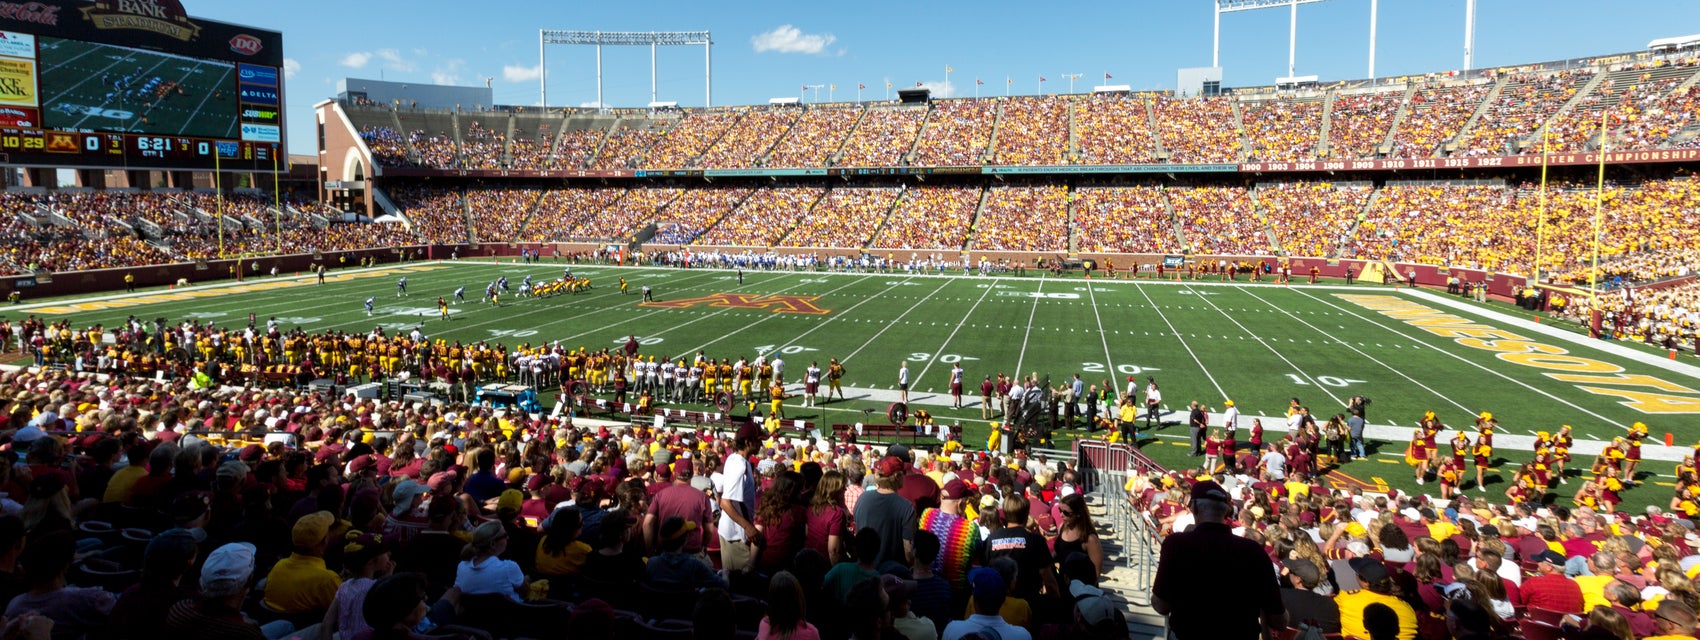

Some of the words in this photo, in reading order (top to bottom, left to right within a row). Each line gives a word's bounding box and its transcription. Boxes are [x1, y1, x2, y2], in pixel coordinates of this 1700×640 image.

[118, 0, 168, 19] BANK
[103, 16, 181, 37] STADIUM
[236, 38, 257, 50] DQ
[250, 90, 276, 98] DELTA
[242, 110, 278, 119] SUBWAY
[3, 136, 20, 148] 10
[24, 138, 44, 148] 29
[86, 136, 98, 150] 0
[138, 136, 172, 150] 6:21
[198, 142, 209, 154] 0
[1478, 158, 1502, 166] 1927
[1586, 150, 1700, 162] CHAMPIONSHIP
[754, 344, 804, 354] 40
[907, 352, 962, 364] 30
[1082, 362, 1142, 374] 20
[1284, 373, 1349, 387] 10
